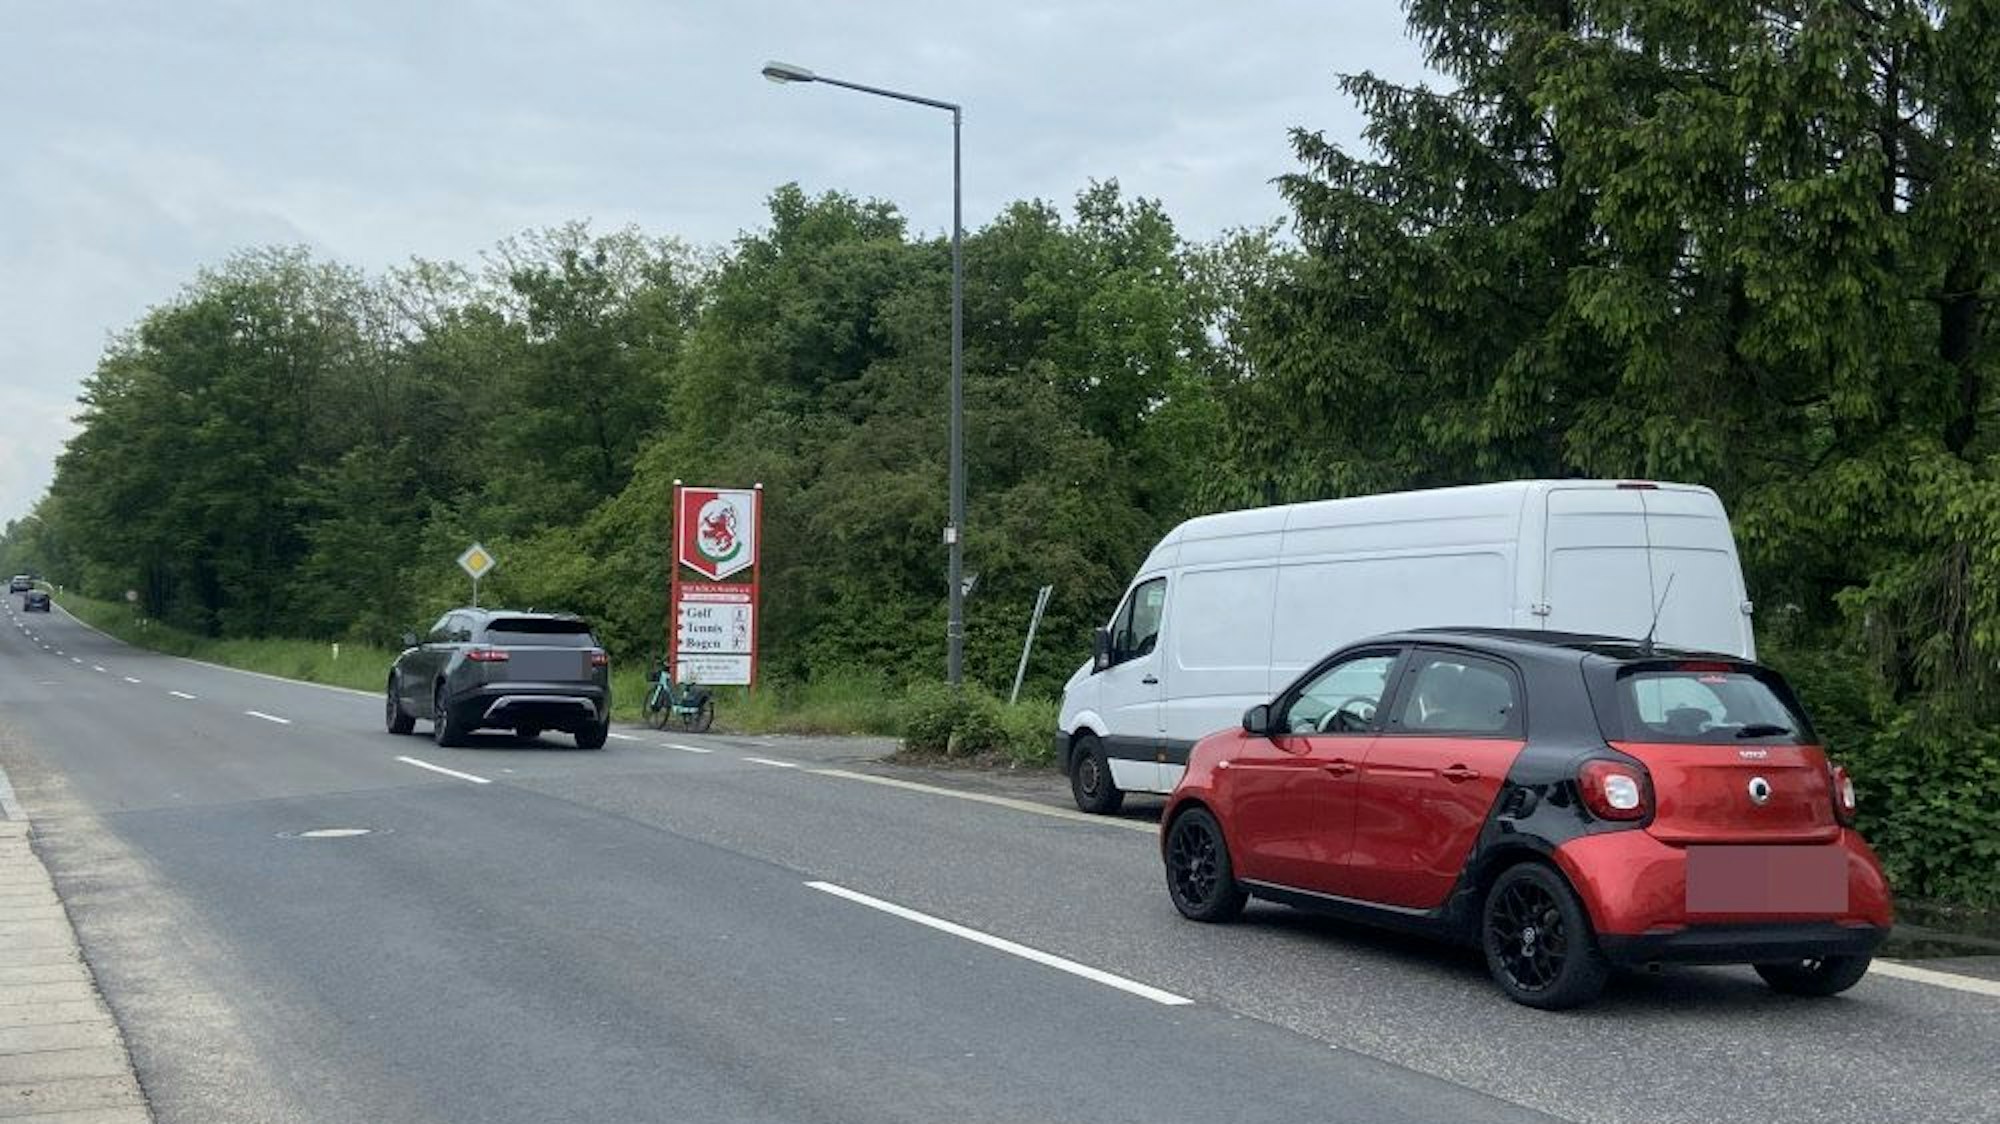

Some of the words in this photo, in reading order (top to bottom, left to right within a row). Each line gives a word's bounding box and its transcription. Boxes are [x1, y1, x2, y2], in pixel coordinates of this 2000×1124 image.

[687, 608, 712, 618] Golf
[688, 623, 722, 633] Tennis
[686, 638, 720, 649] Bogen
